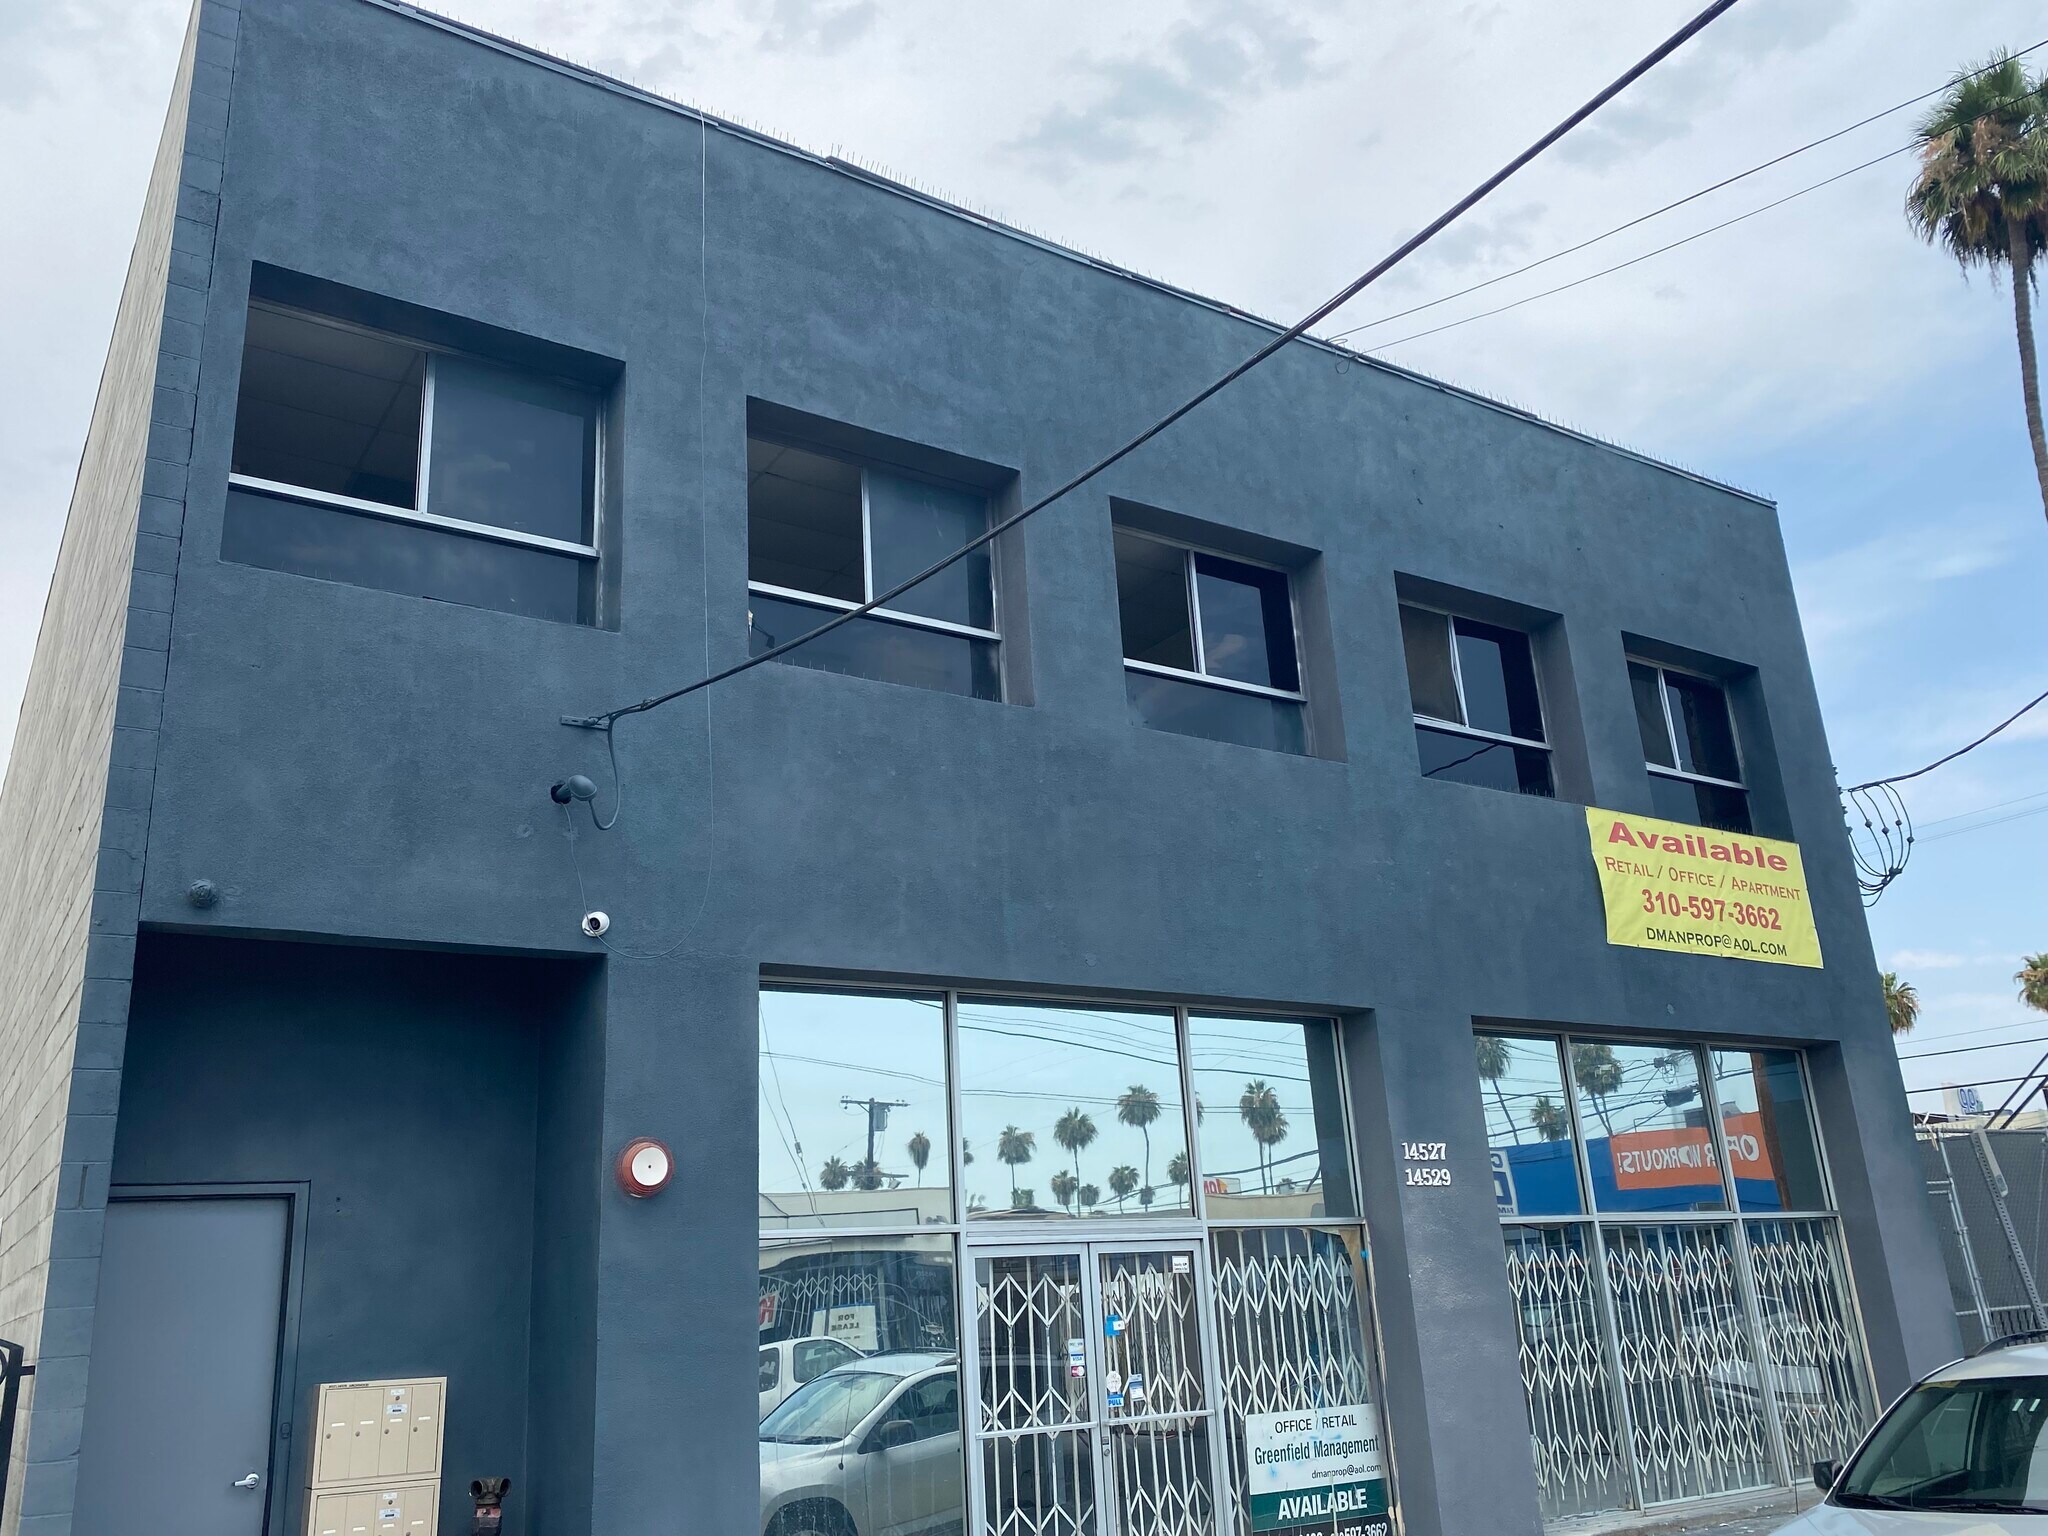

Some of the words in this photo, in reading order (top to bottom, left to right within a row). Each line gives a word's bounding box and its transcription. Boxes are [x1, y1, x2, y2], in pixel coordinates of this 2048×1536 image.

[1608, 821, 1788, 872] Available
[1641, 888, 1782, 930] 310-597-3662
[1646, 927, 1787, 956] DMANPROP@AOL.COM
[1401, 1142, 1446, 1160] 14527
[1405, 1168, 1451, 1186] 14529
[1275, 1418, 1312, 1434] OFFICE
[1321, 1414, 1358, 1429] RETAIL
[1254, 1441, 1311, 1465] Greenfield
[1313, 1434, 1380, 1459] Management
[1277, 1488, 1368, 1520] AVAILABLE
